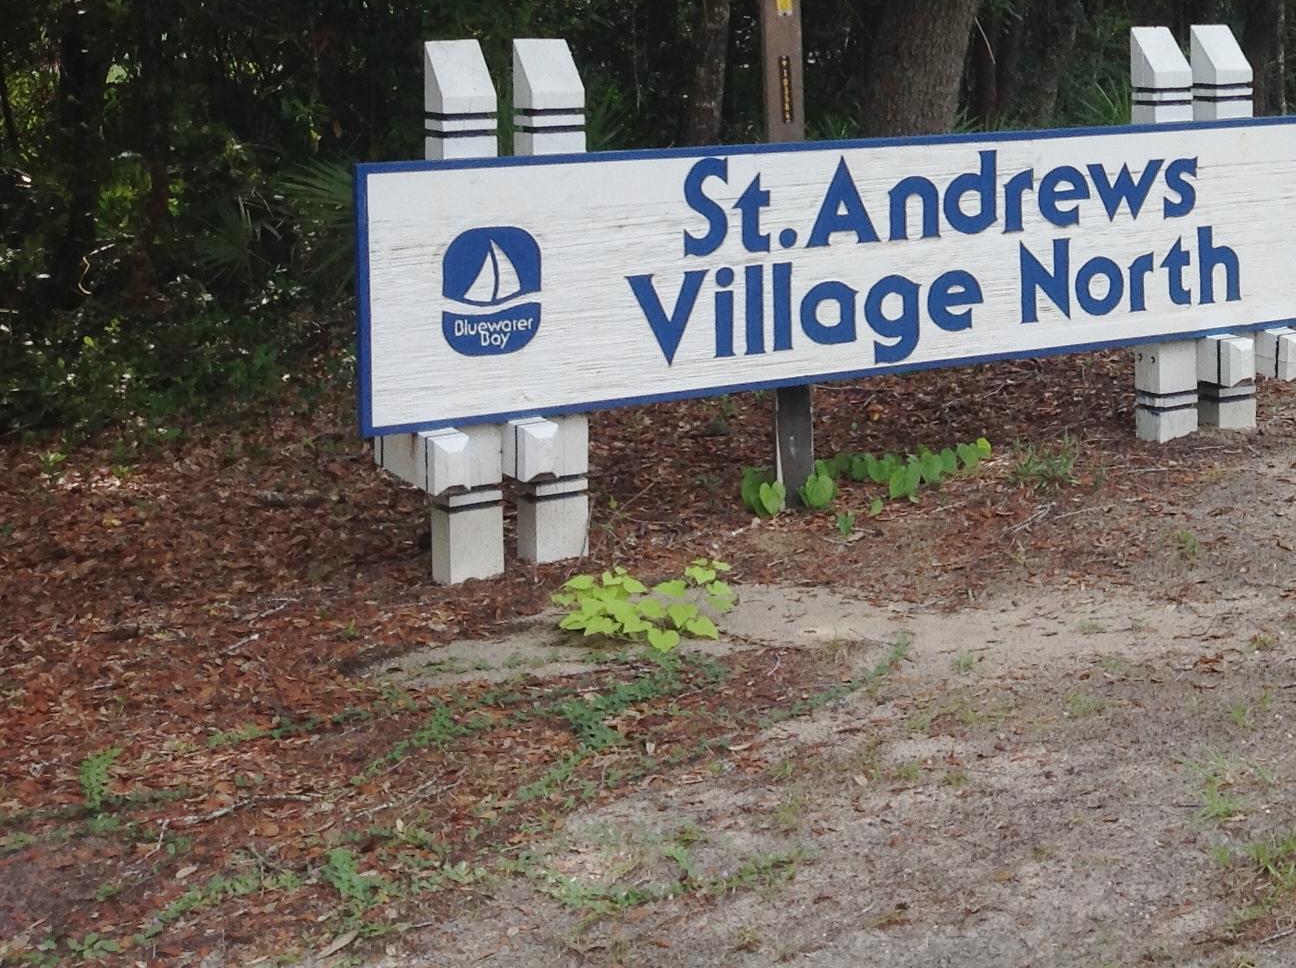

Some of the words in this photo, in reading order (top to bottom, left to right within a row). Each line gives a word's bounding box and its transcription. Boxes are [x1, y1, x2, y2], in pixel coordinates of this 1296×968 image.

[626, 262, 983, 365] Village
[1019, 226, 1240, 324] North
[454, 317, 534, 337] Bluewater
[480, 330, 511, 349] Bay
